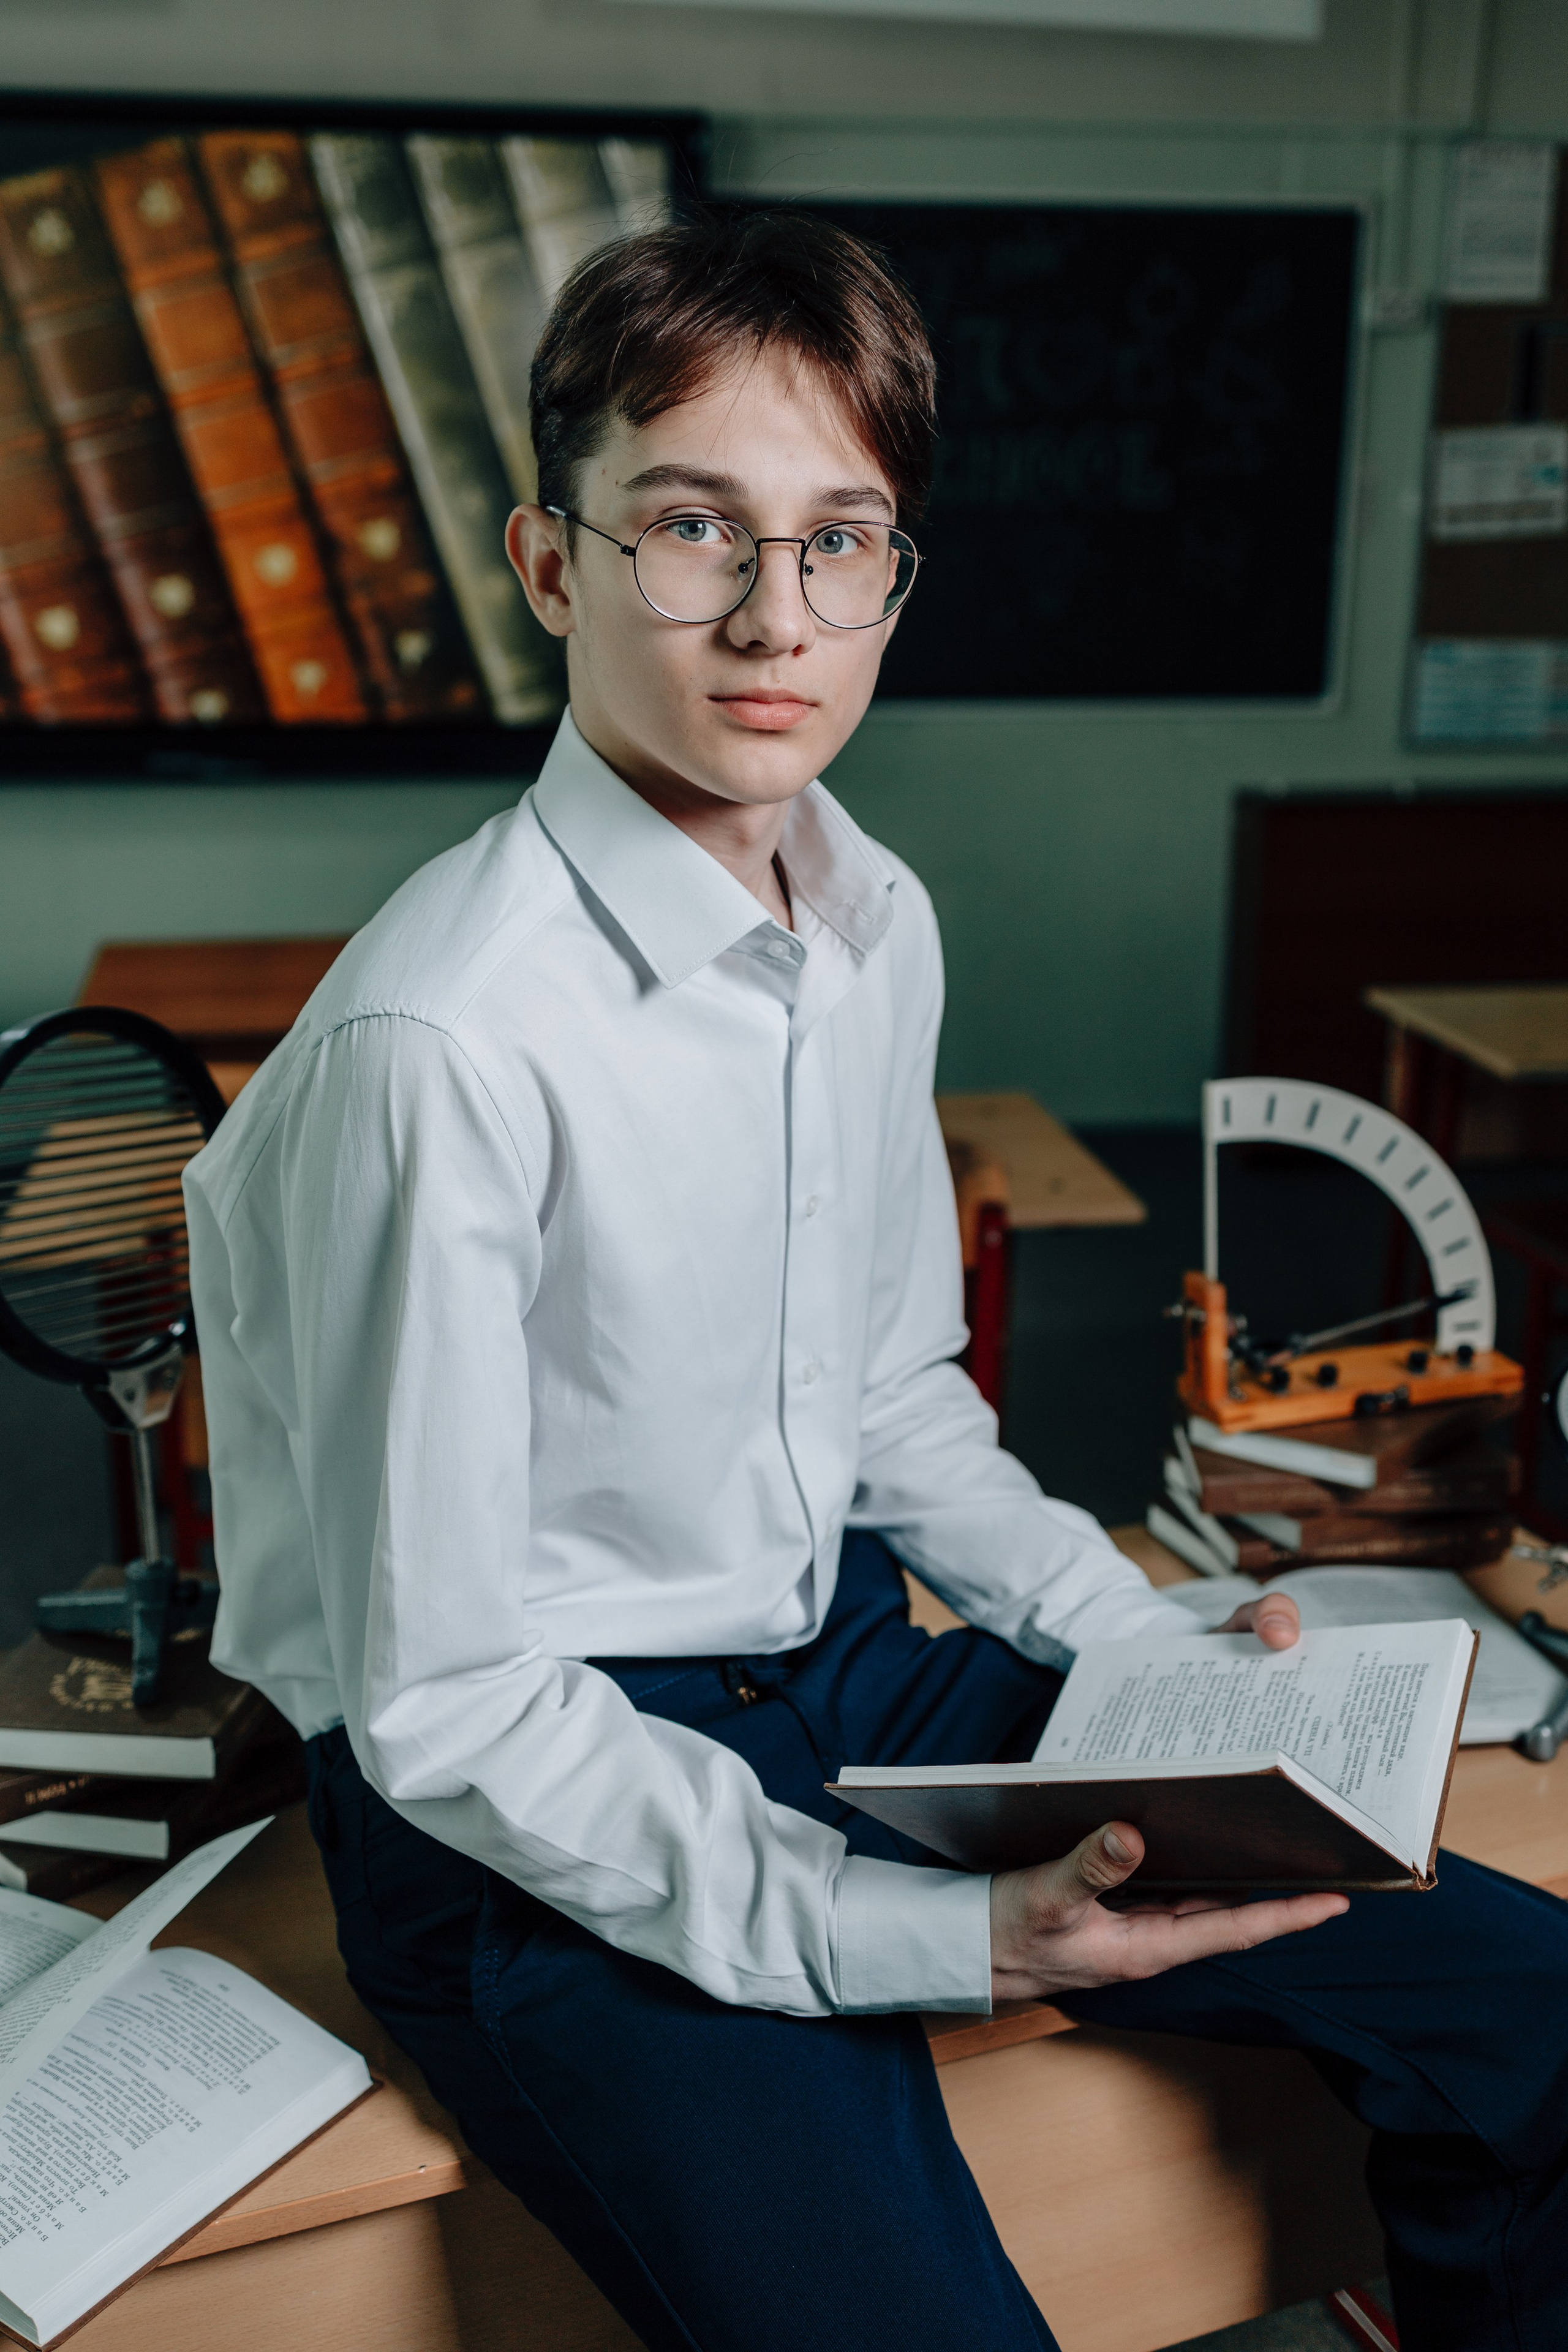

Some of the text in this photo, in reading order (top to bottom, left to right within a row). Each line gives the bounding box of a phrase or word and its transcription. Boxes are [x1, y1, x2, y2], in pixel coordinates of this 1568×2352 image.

[1396, 1744, 1406, 1761] виде.
[1384, 1759, 1393, 1777] дядя,
[1344, 1770, 1356, 1796] планом.
[35, 2146, 49, 2157] ней
[51, 2136, 67, 2149] день
[64, 2136, 82, 2150] ждем
[8, 2146, 31, 2166] одежда,
[16, 2143, 46, 2167] Макбету:
[53, 2148, 77, 2169] (тихо).
[64, 2148, 100, 2179] Ненастный
[30, 2165, 45, 2176] нам
[45, 2165, 70, 2186] почесть
[53, 2160, 74, 2178] как-то
[7, 2180, 32, 2201] (тихо).
[13, 2172, 39, 2195] венчать,
[43, 2176, 55, 2188] Что
[73, 2177, 86, 2189] Все
[7, 2195, 32, 2213] упоен!
[37, 2194, 56, 2211] Меня
[7, 2217, 25, 2234] Меня
